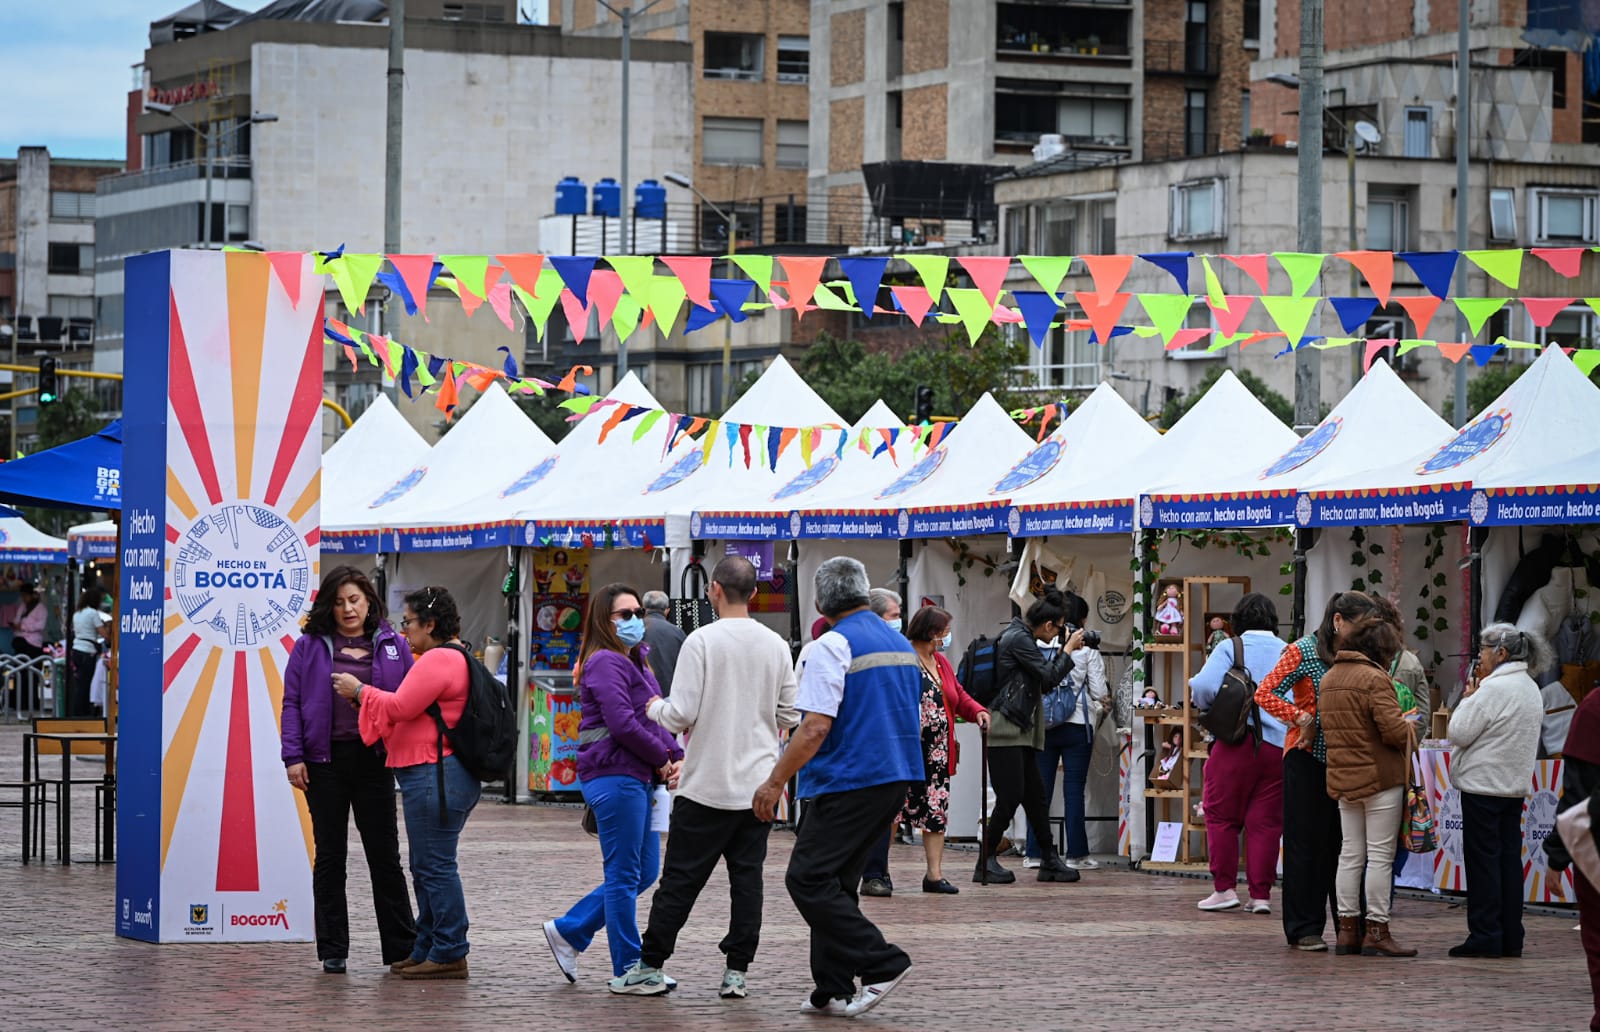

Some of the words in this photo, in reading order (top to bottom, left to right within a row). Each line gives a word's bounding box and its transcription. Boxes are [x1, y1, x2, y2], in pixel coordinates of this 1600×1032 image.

[1159, 508, 1179, 523] Hecho
[1180, 511, 1195, 523] con
[1195, 511, 1213, 523] amor,
[1214, 506, 1236, 521] hecho
[1236, 510, 1246, 520] en
[1246, 505, 1272, 523] Bogotá
[1320, 505, 1343, 521] Hecho
[1344, 509, 1358, 520] con
[1358, 508, 1379, 521] amor,
[1380, 502, 1404, 518] hecho
[1405, 506, 1413, 517] en
[1413, 499, 1444, 520] Bogotá
[1497, 503, 1523, 519] Hecho
[1524, 506, 1540, 518] con
[1541, 505, 1565, 519] amor,
[1566, 500, 1594, 517] hecho
[129, 508, 156, 541] ¡Hecho
[805, 521, 820, 534] Hecho
[821, 524, 829, 534] con
[828, 523, 842, 535] amor,
[842, 521, 858, 534] hecho
[858, 524, 864, 534] en
[864, 521, 883, 537] Bogotá
[913, 519, 929, 532] Hecho
[929, 522, 939, 532] con
[939, 521, 952, 533] amor,
[973, 514, 995, 531] Bogotá
[1025, 517, 1041, 531] Hecho
[1041, 519, 1051, 530] con
[1051, 519, 1064, 531] amor,
[1065, 515, 1083, 529] hecho
[1083, 518, 1092, 528] en
[1092, 513, 1114, 530] Bogotá
[124, 548, 138, 568] con
[138, 548, 160, 570] amor,
[217, 560, 251, 569] HECHO
[253, 560, 267, 569] EN
[129, 575, 153, 600] hecho
[195, 569, 287, 589] BOGOTÁ
[121, 612, 131, 633] en
[131, 608, 162, 640] Bogotá!
